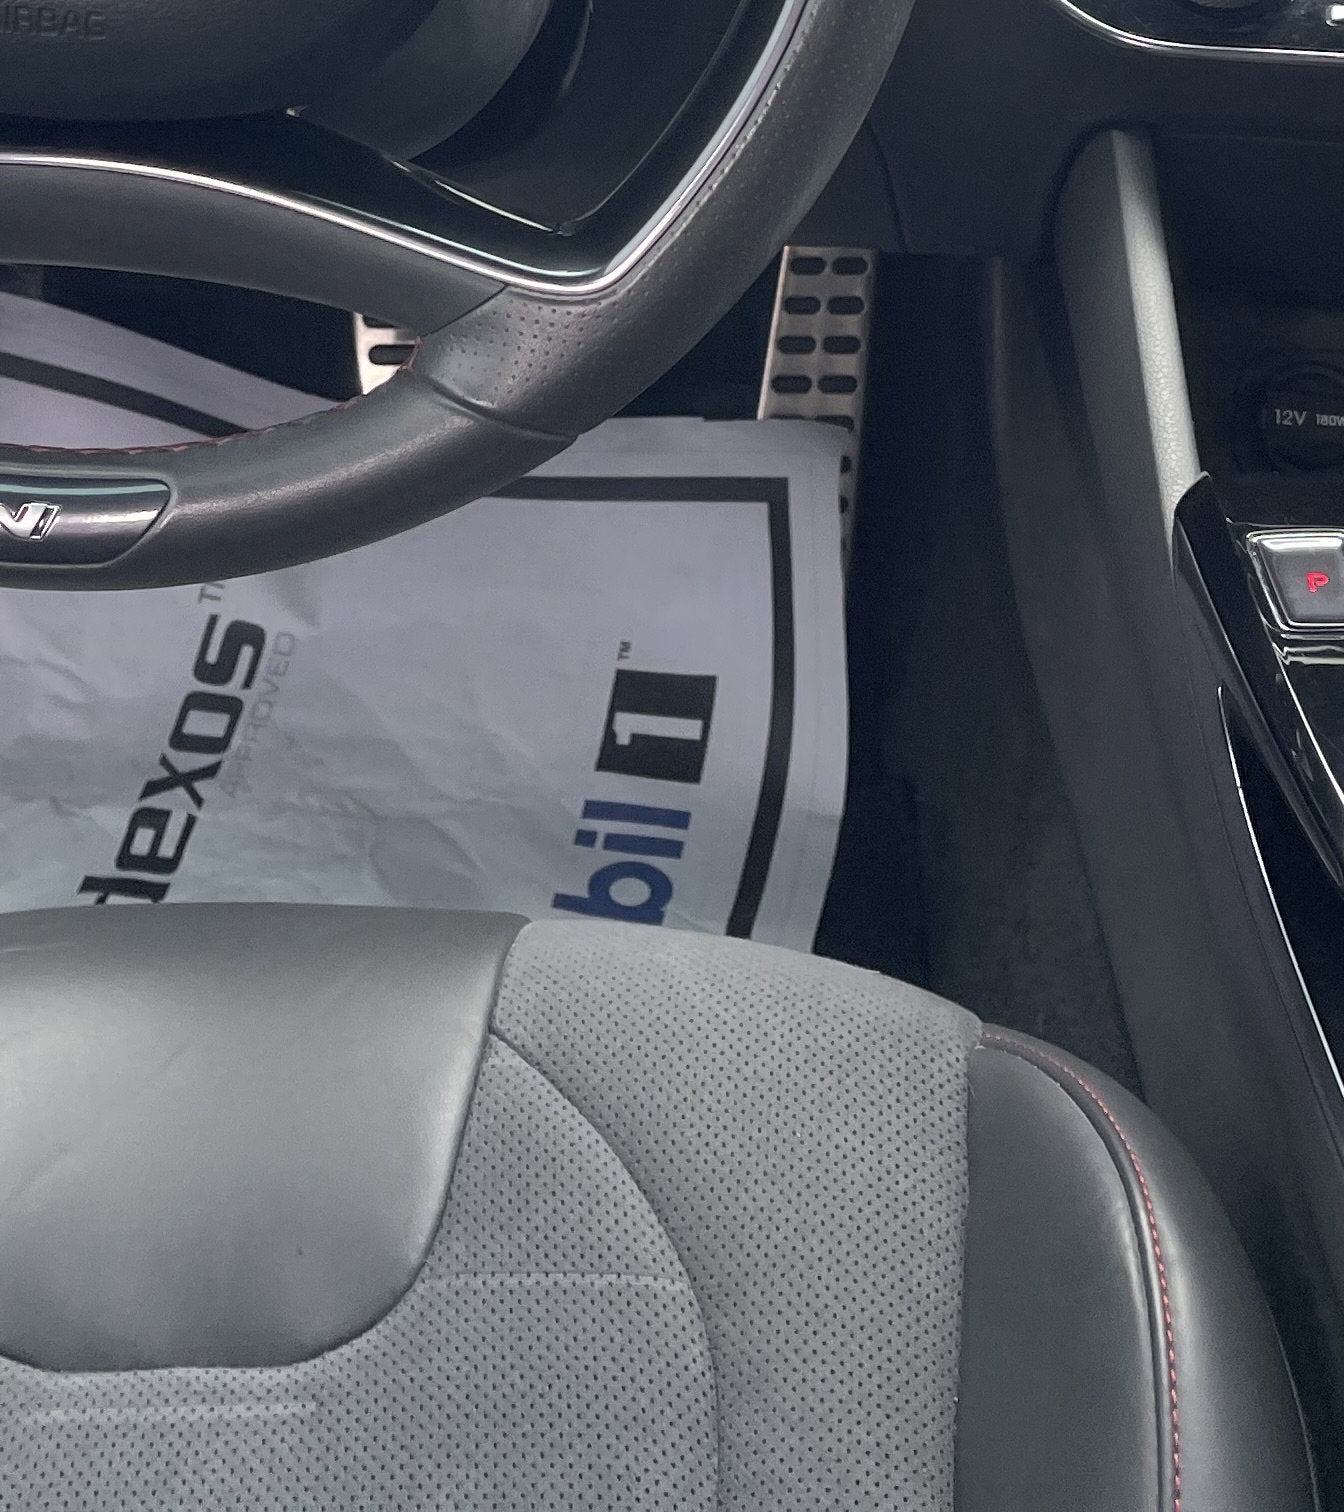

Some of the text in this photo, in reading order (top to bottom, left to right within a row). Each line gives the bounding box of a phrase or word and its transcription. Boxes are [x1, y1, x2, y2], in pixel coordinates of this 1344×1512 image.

[1274, 408, 1308, 428] 12V
[1305, 571, 1330, 594] P
[617, 640, 633, 661] TM
